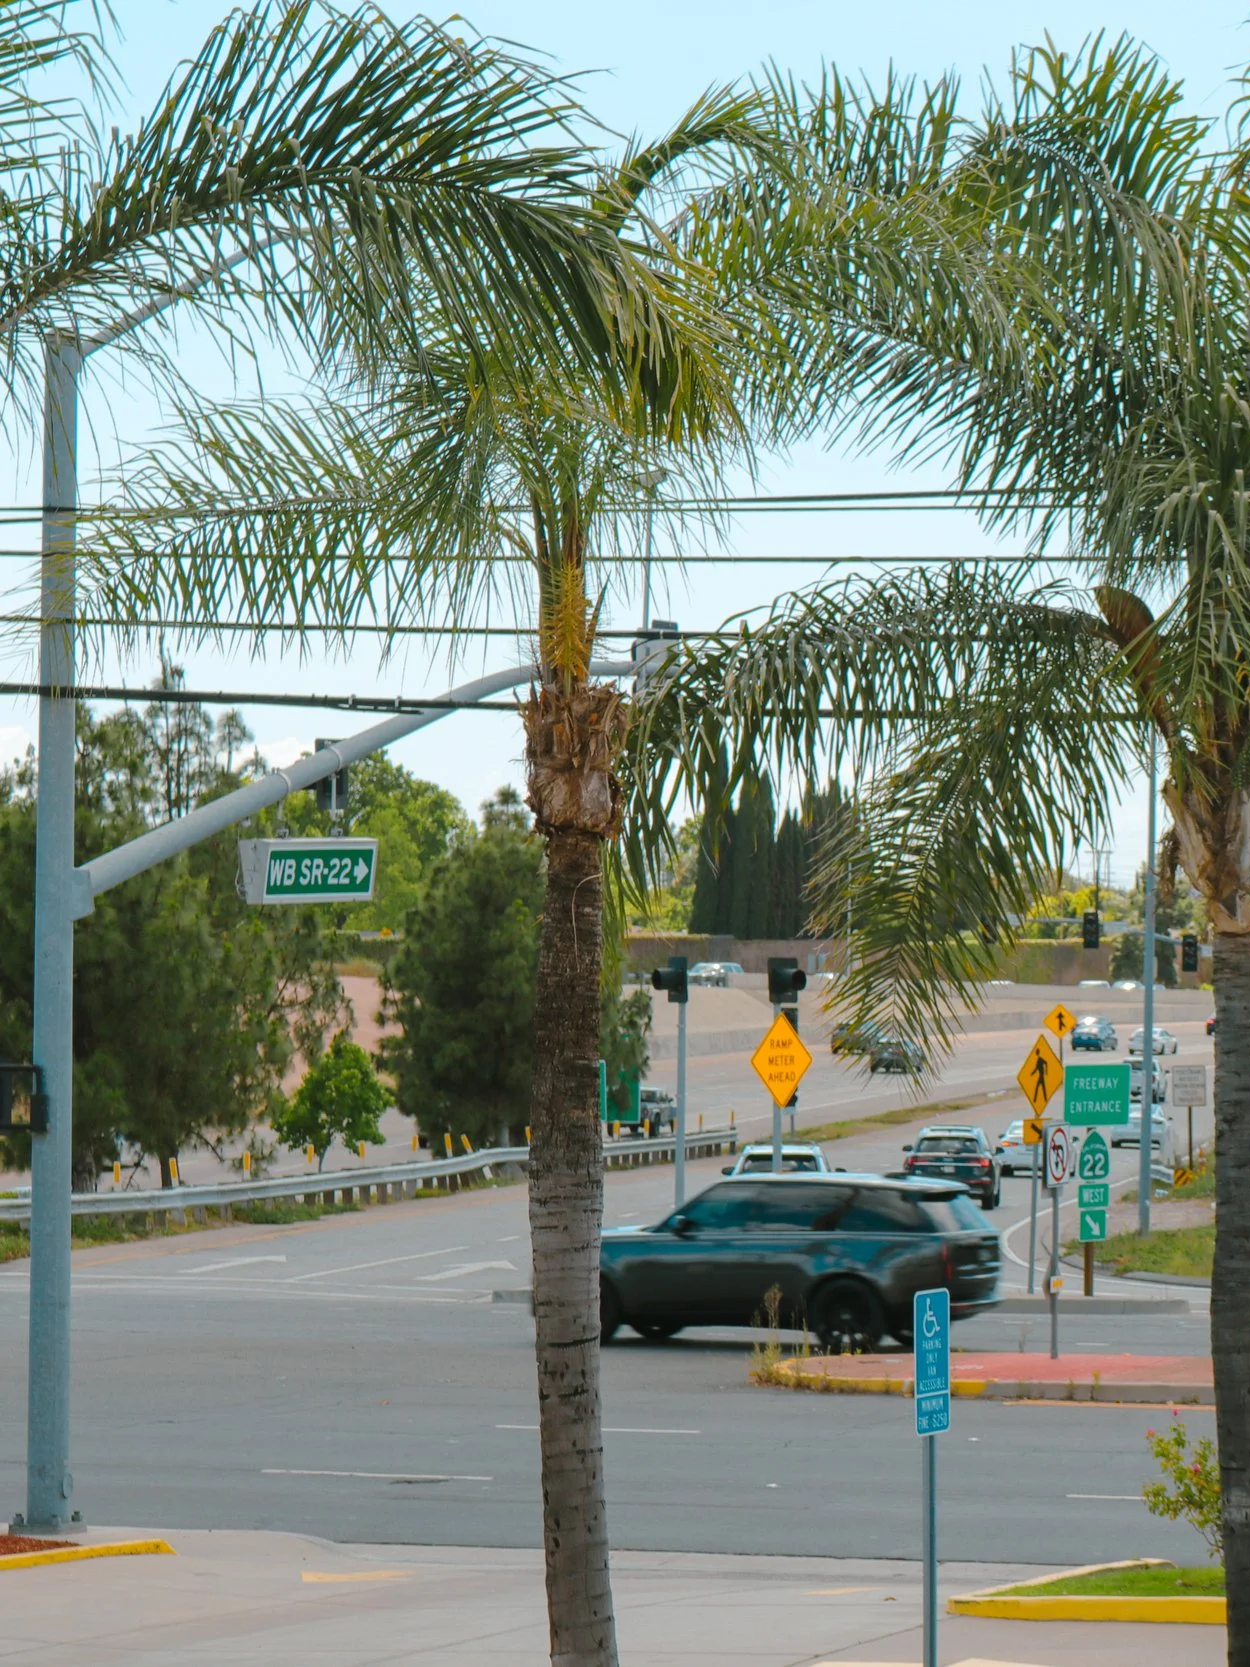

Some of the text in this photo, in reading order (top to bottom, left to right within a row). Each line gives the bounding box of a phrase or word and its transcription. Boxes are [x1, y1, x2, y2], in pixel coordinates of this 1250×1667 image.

[269, 857, 352, 887] WB SR-22
[769, 1039, 793, 1049] RAMP
[767, 1055, 795, 1066] METER
[767, 1072, 796, 1082] AHEAD
[1072, 1077, 1119, 1091] FREEWAY
[1069, 1100, 1122, 1114] ENTRANCE
[1083, 1152, 1106, 1177] 22
[1081, 1187, 1105, 1204] WEST
[922, 1338, 942, 1349] PARKING
[926, 1351, 938, 1364] ONLY
[921, 1398, 944, 1412] MINIMUM
